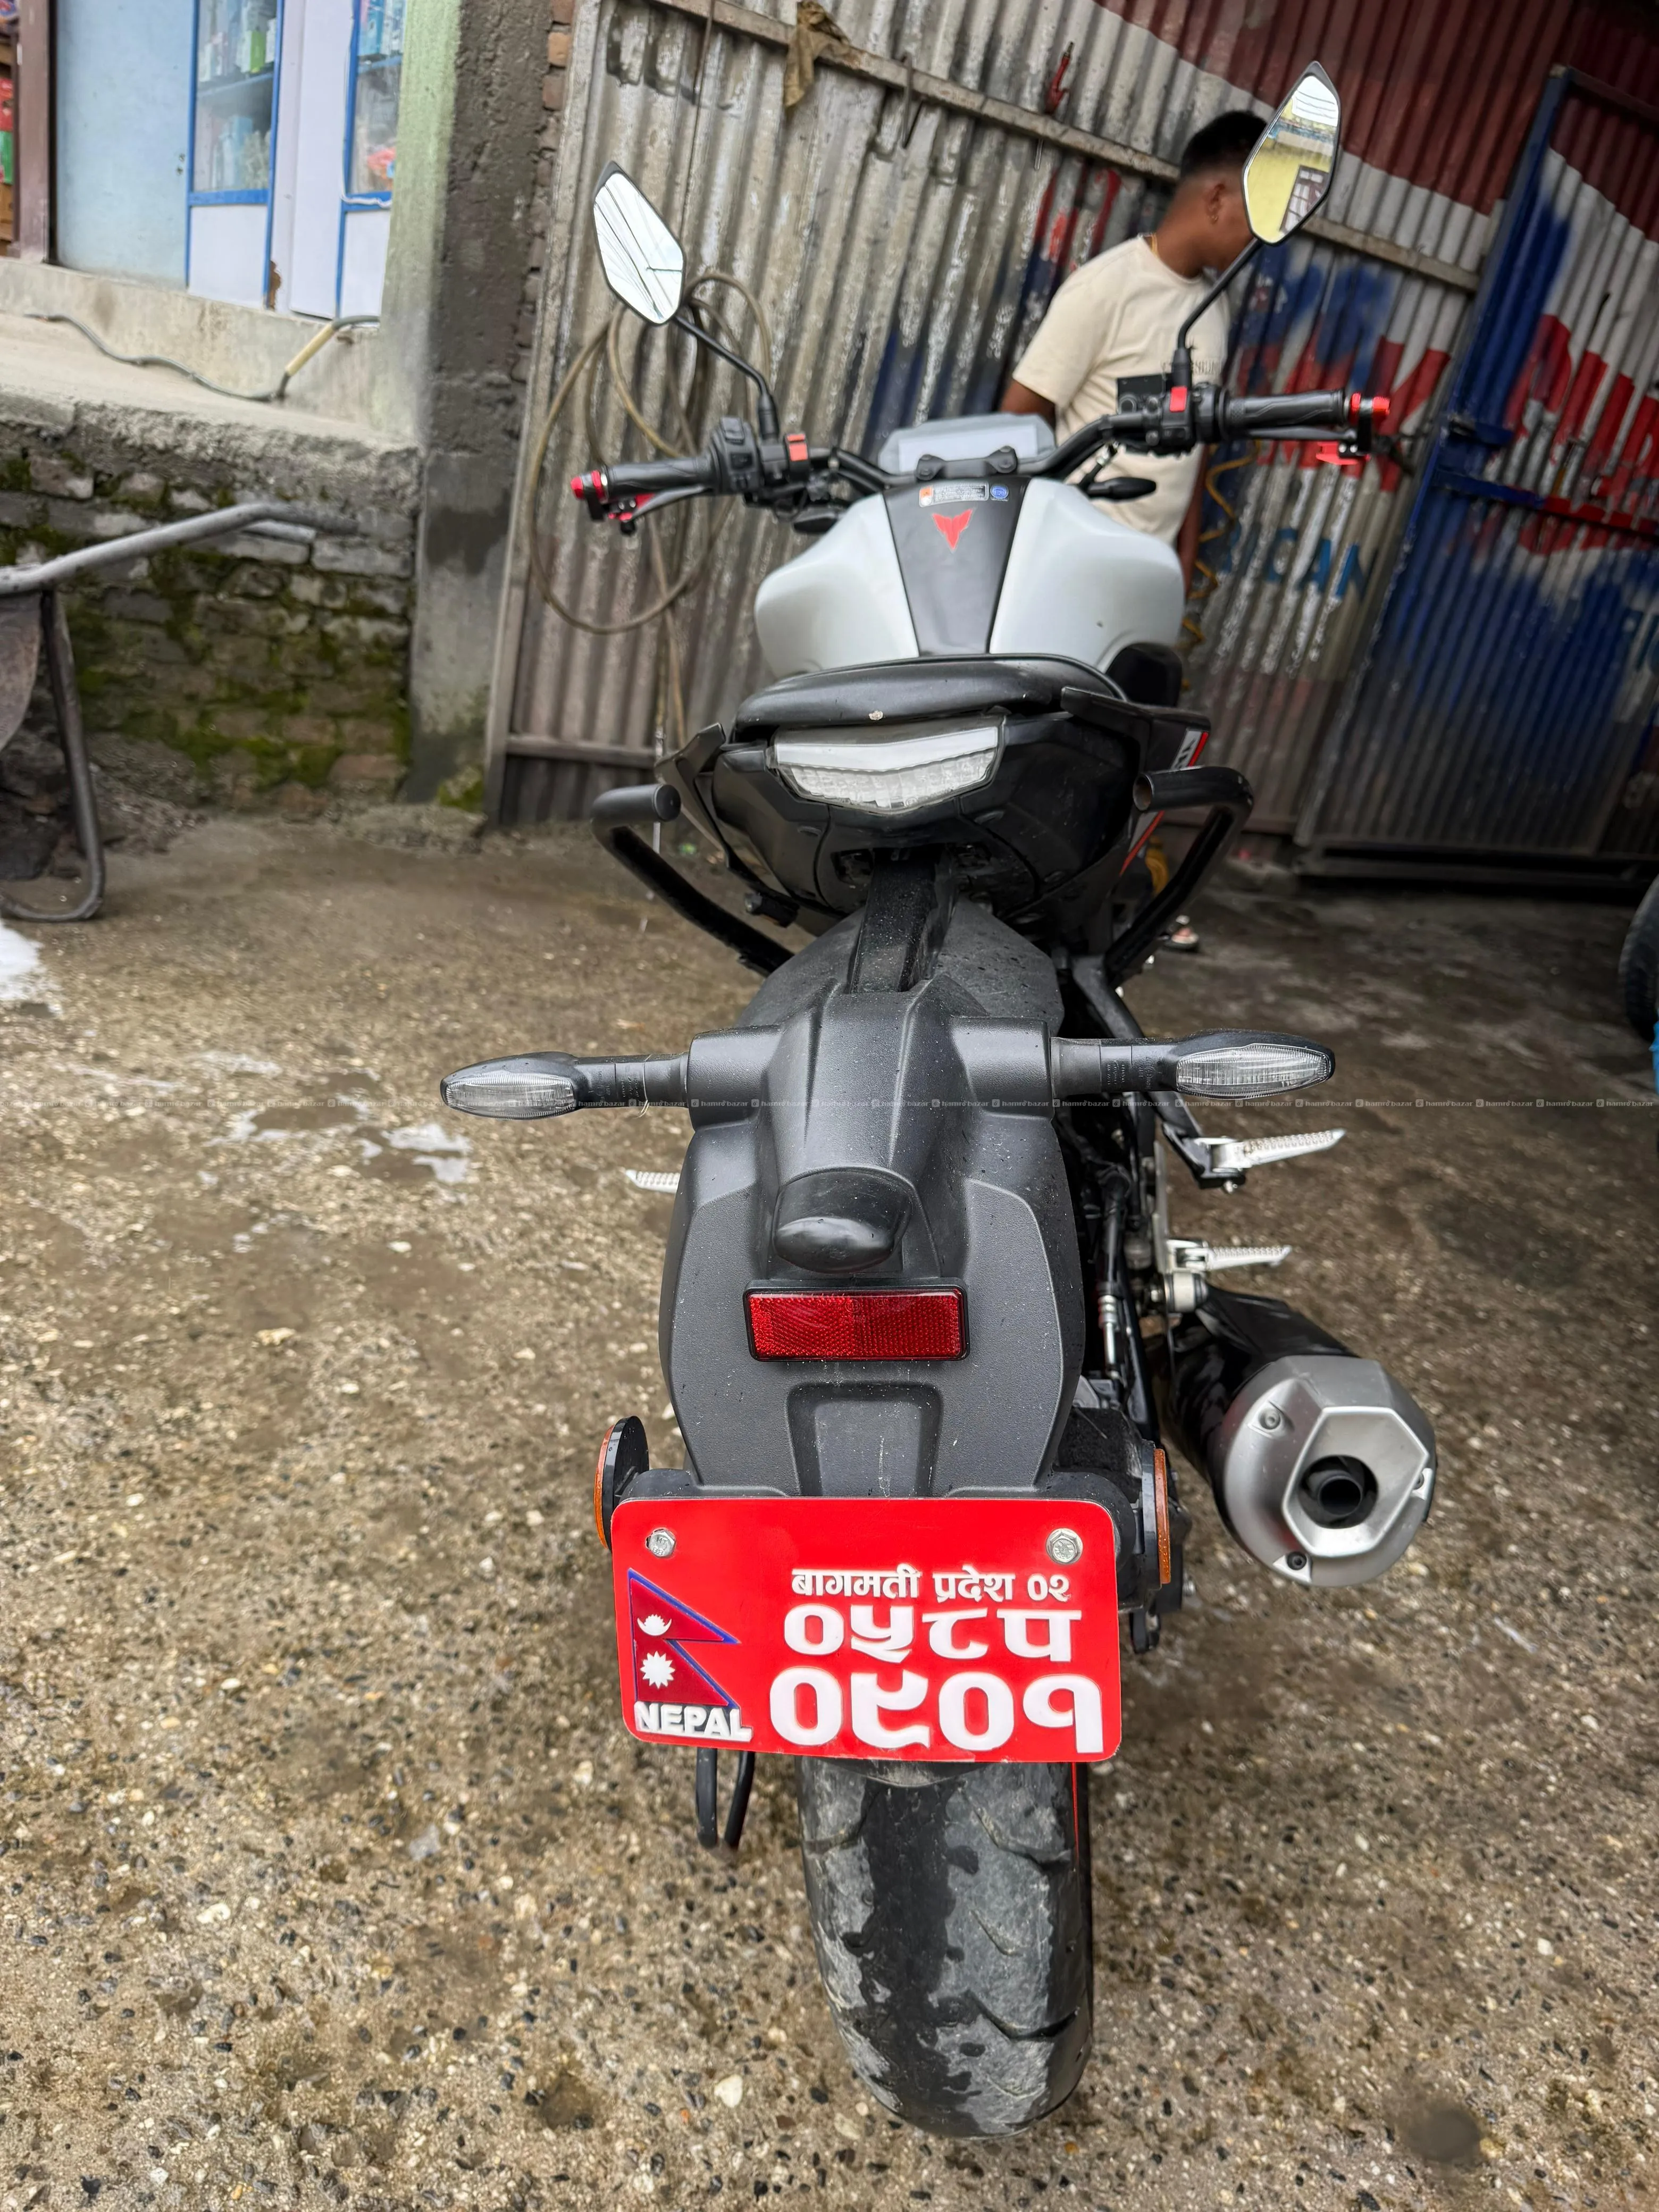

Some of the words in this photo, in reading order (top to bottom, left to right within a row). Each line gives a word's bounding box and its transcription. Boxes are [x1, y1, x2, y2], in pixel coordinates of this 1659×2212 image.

[791, 1563, 921, 1599] बागमती
[932, 1564, 1016, 1603] प्रदेश
[1027, 1573, 1071, 1602] ०२
[634, 1701, 753, 1742] NEPAL
